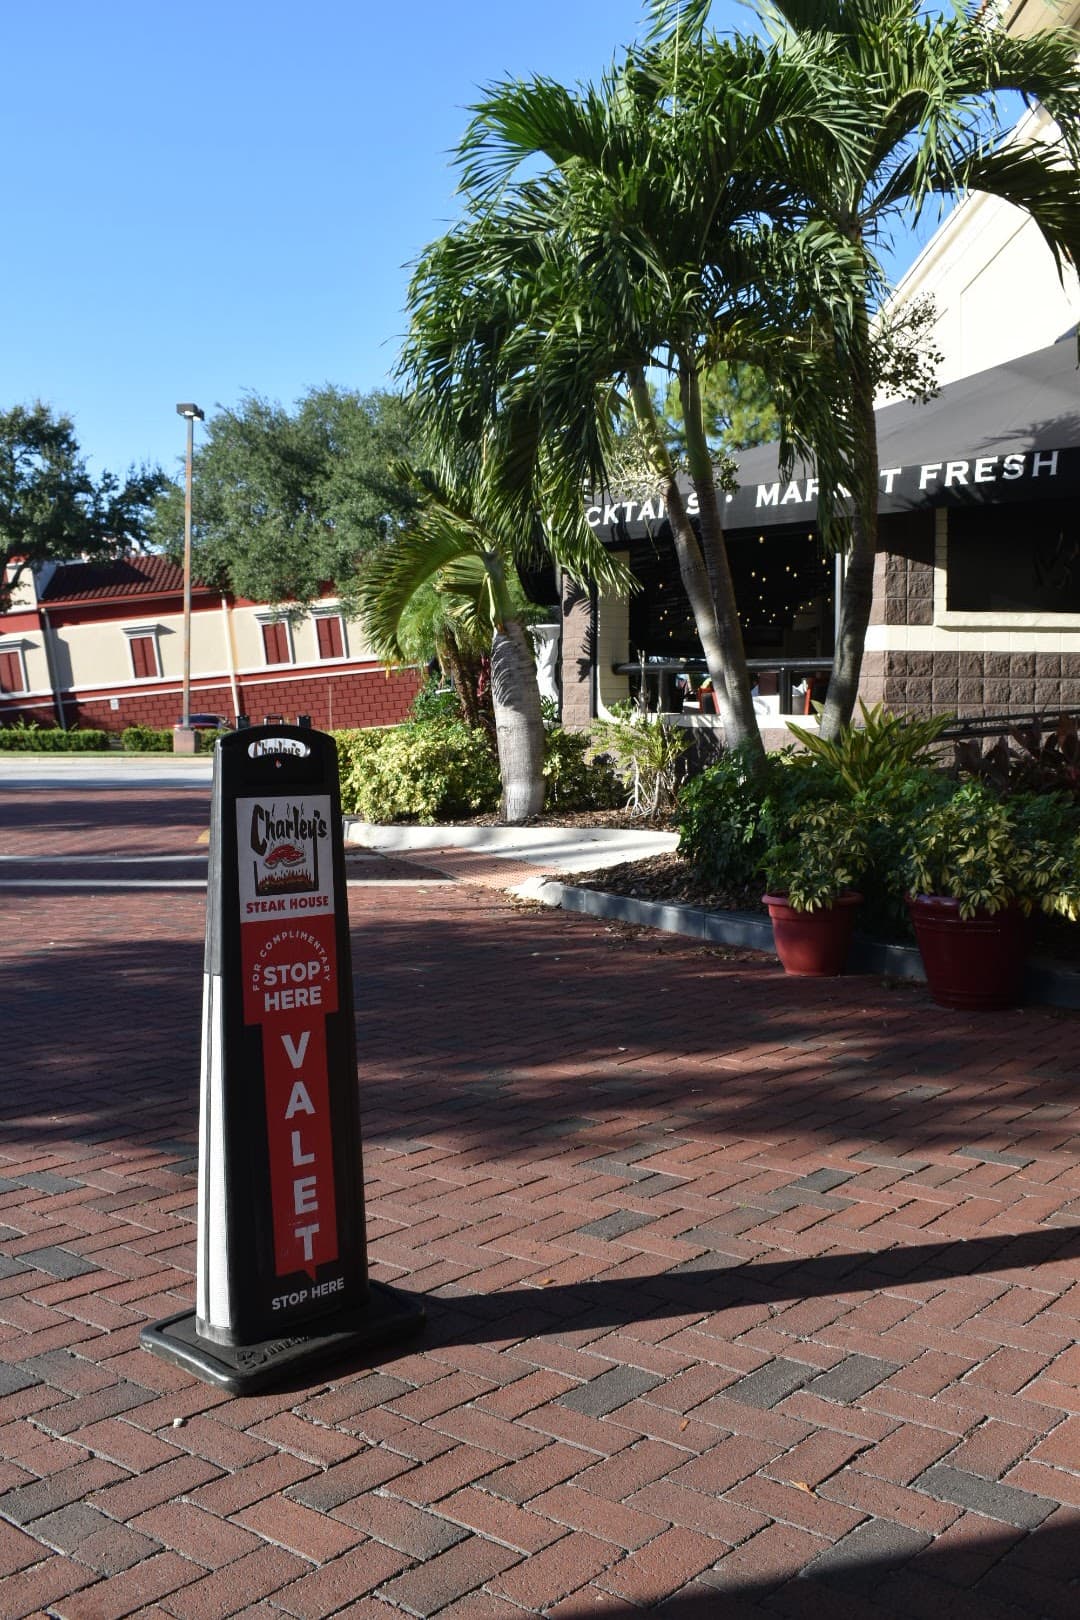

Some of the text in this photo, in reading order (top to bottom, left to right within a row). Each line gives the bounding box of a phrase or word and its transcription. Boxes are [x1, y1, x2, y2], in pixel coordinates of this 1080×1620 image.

[547, 451, 1059, 531] CKTAIS MART FRESH
[250, 804, 328, 856] Charley's
[246, 896, 329, 914] STEAK HOUSE
[252, 930, 330, 992] FOR COMPLIMENTARY
[263, 961, 321, 986] STOP
[264, 985, 323, 1012] HERE
[280, 1031, 320, 1261] VALET
[272, 1277, 345, 1311] STOP HERE
